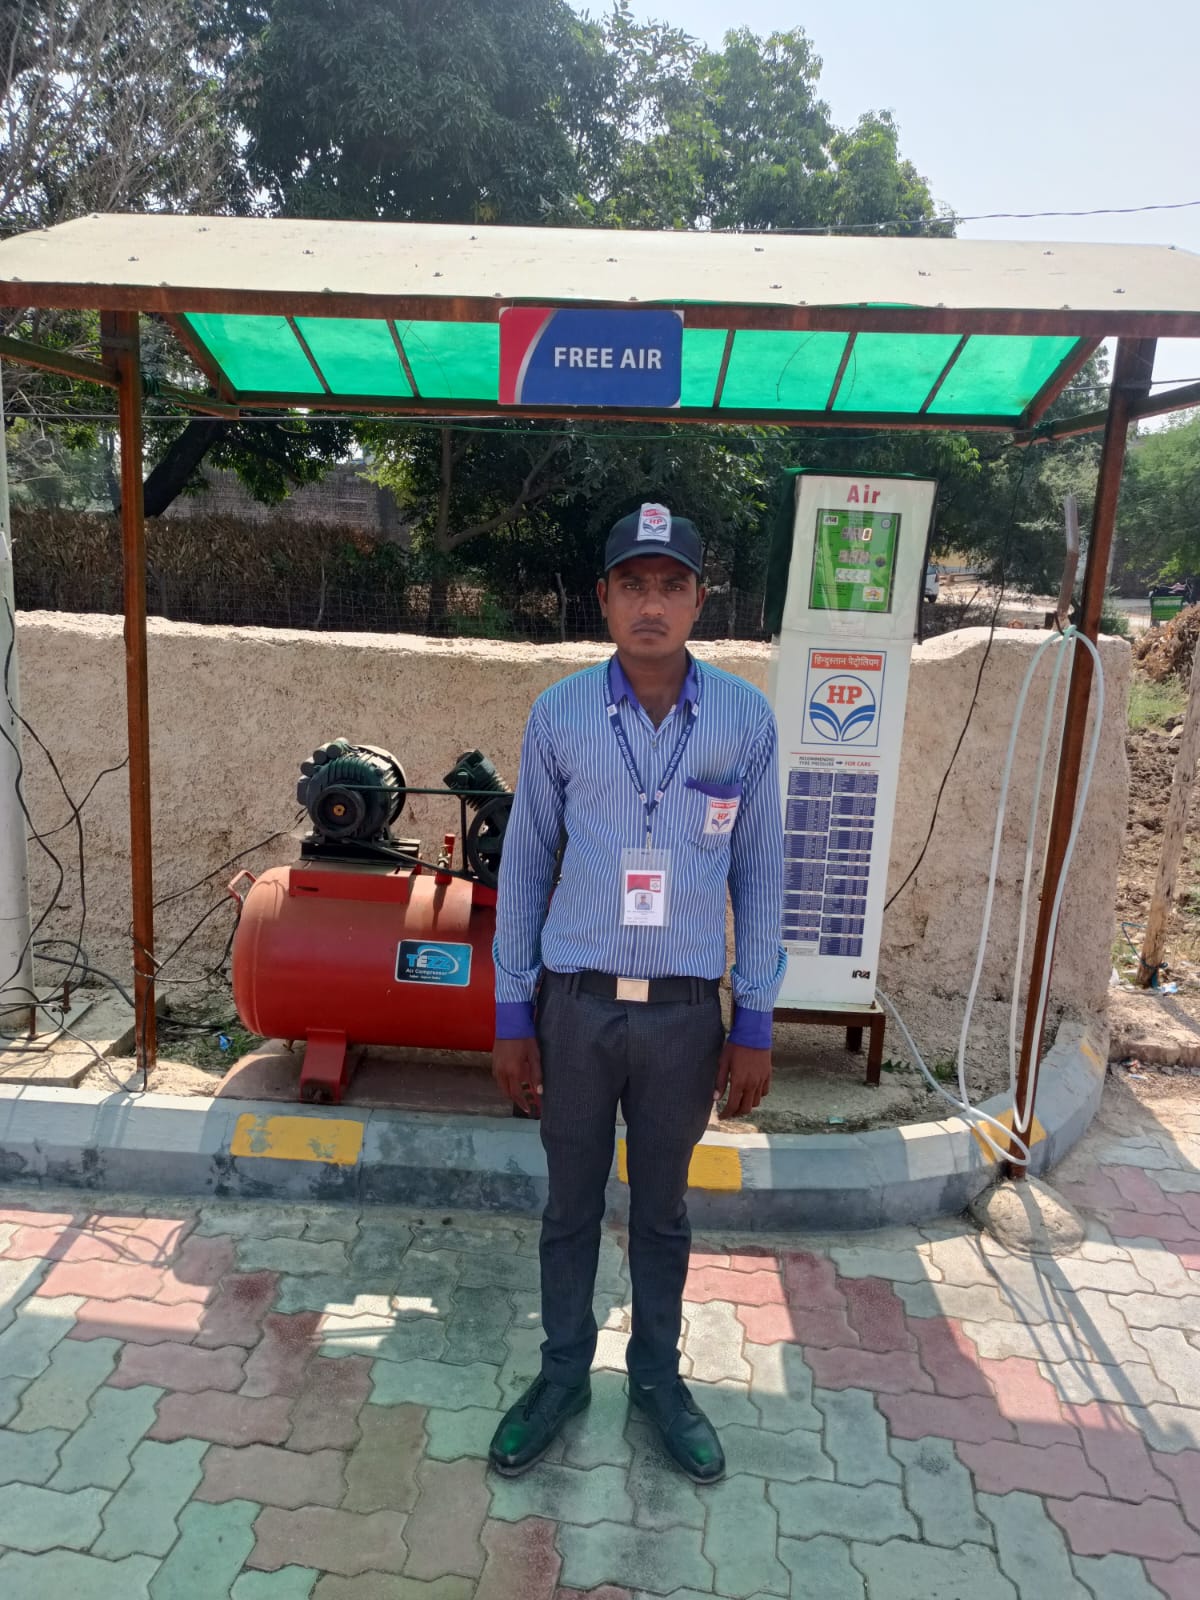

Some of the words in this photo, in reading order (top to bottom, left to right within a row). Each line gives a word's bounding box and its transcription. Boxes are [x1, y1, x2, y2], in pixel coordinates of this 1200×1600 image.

[554, 347, 613, 368] FREE
[620, 348, 662, 369] AIR
[847, 484, 880, 504] Air
[862, 528, 872, 541] 0
[826, 685, 863, 704] HP
[406, 954, 450, 969] TEZZ
